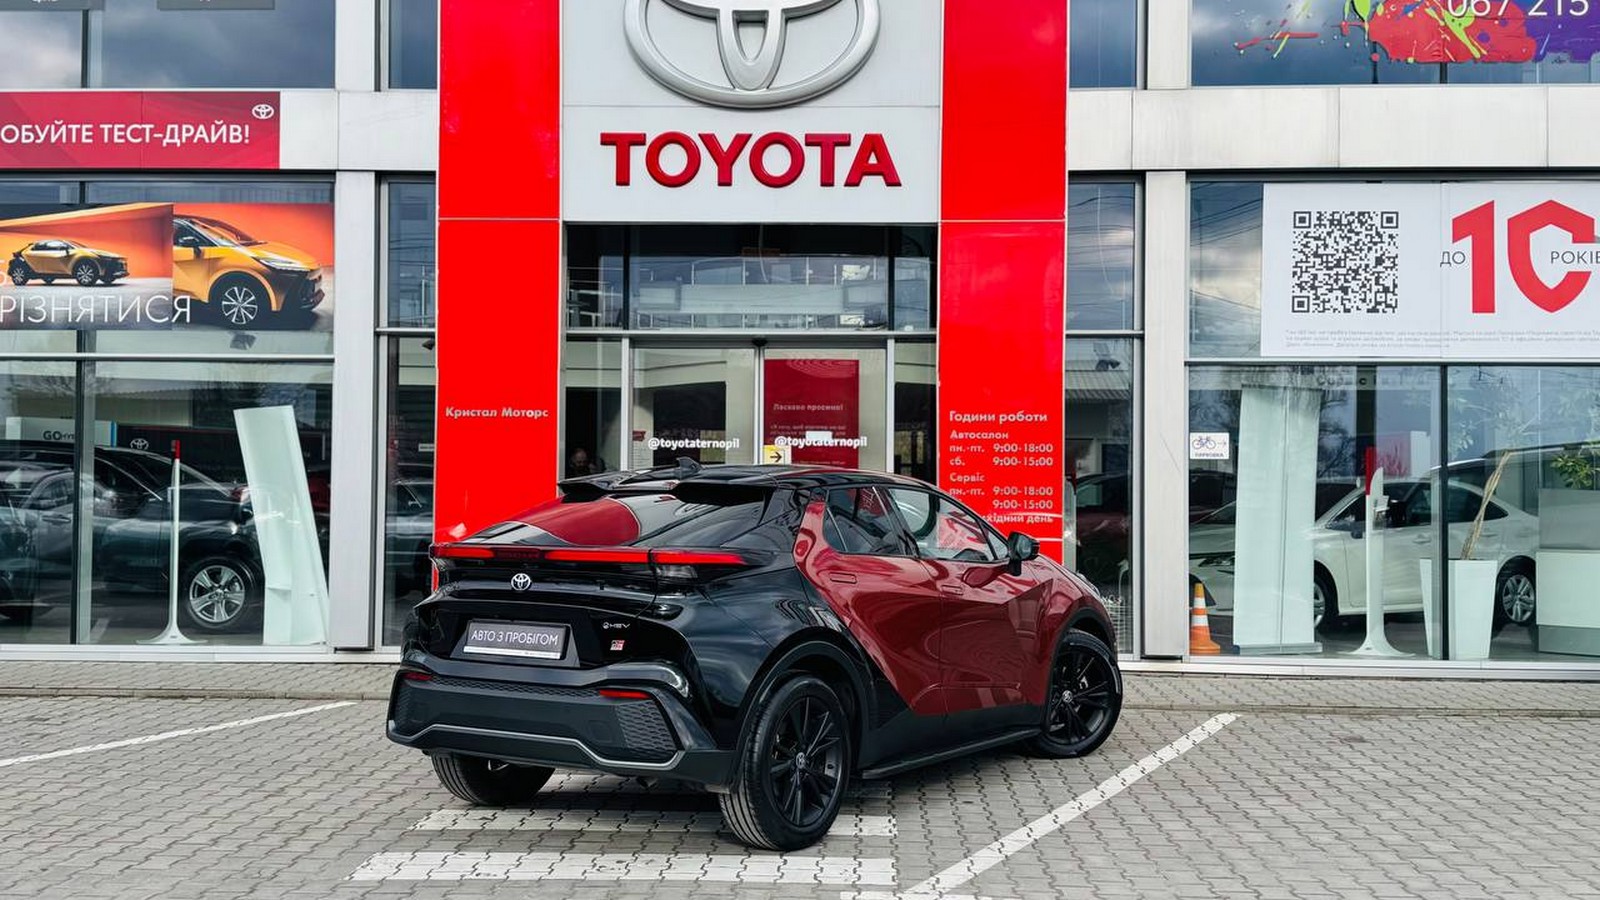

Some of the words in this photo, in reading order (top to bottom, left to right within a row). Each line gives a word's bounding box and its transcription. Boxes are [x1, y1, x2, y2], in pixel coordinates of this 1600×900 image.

[0, 120, 93, 144] ОБУЙТЕ
[100, 120, 250, 147] ТЕСТ-ДРАЙВ!
[600, 131, 902, 188] TOYOTA
[1440, 251, 1466, 267] ДО
[0, 295, 191, 323] РІЗНЯТИСЯ
[445, 407, 497, 419] Кристал
[502, 407, 549, 419] Моторс
[949, 410, 996, 422] Години
[999, 410, 1048, 425] роботи
[950, 429, 1009, 440] Автосалон
[648, 437, 740, 450] @toyotaternopil
[774, 436, 867, 449] @toyotaternopil
[949, 456, 965, 466] сб.
[949, 472, 985, 484] Сервіс
[1027, 514, 1054, 524] день
[471, 630, 496, 641] АВТО
[497, 631, 504, 642] З
[505, 631, 559, 645] ПРОБІГОМ
